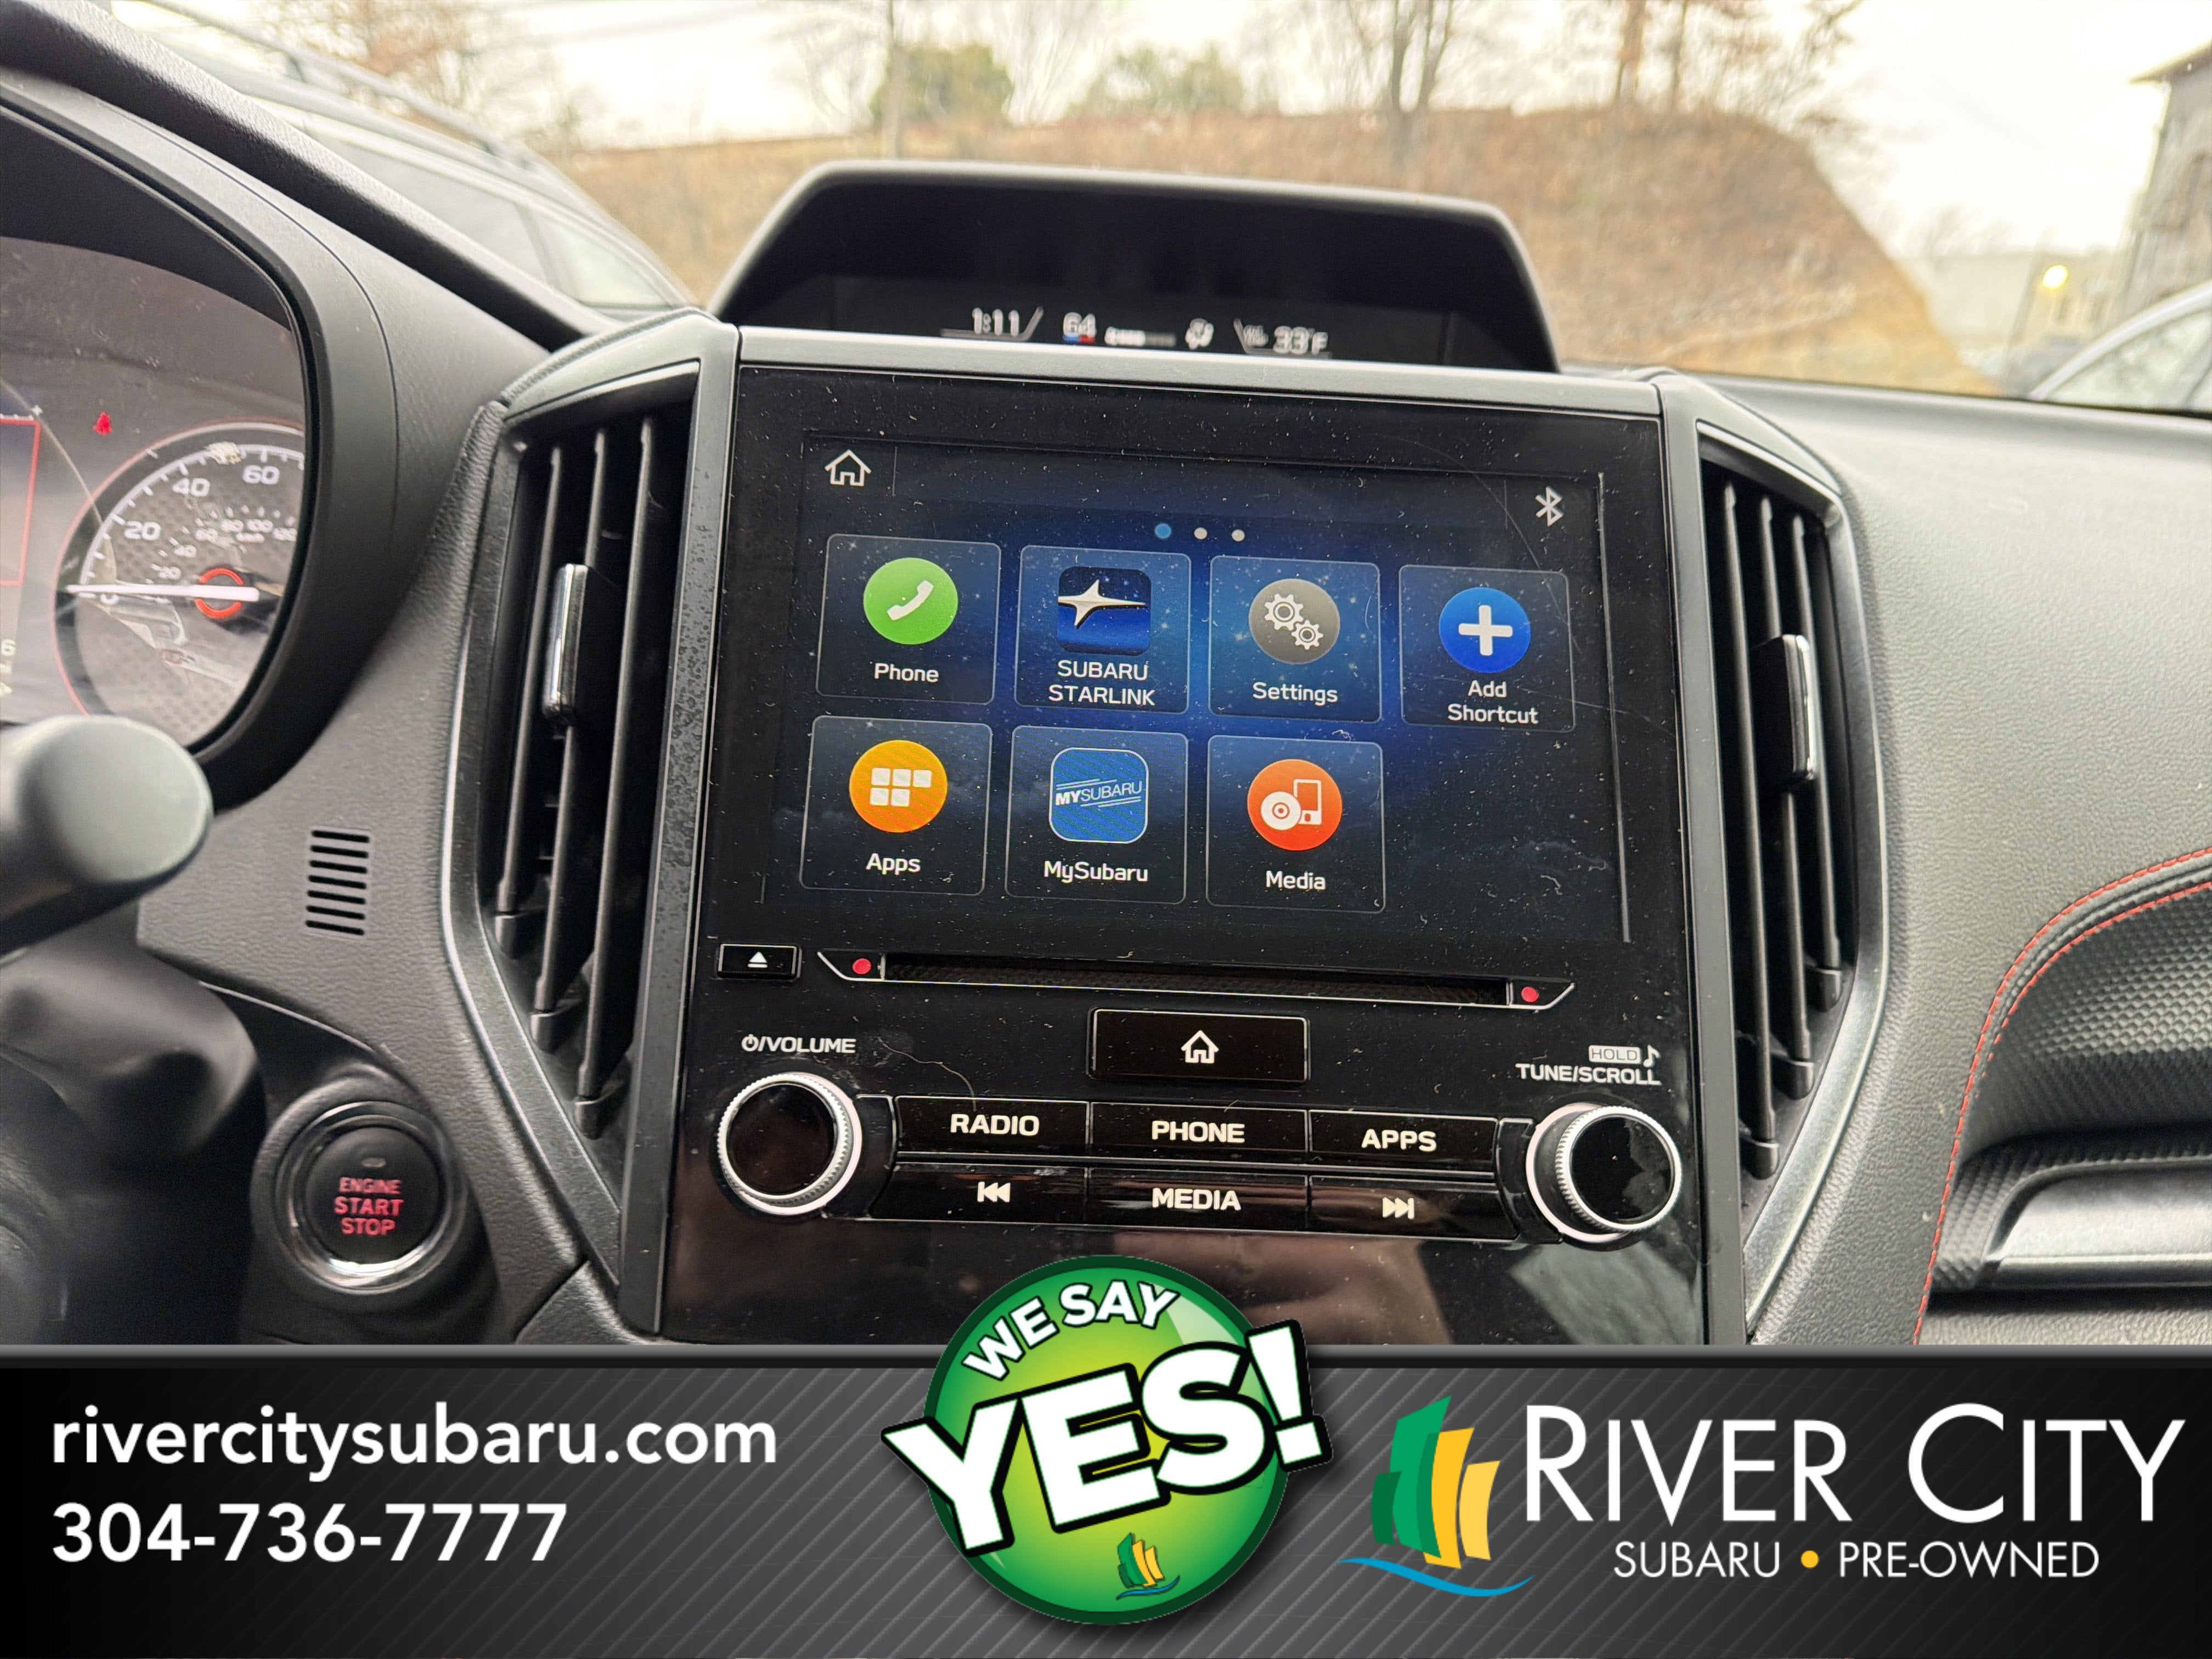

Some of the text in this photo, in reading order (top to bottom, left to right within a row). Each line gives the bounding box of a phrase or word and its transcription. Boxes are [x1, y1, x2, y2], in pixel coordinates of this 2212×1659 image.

[972, 307, 1019, 337] 1:11
[1063, 312, 1096, 337] 64
[243, 465, 279, 485] 60
[173, 478, 210, 498] 40
[124, 521, 161, 540] 20
[874, 663, 939, 682] Phone
[1057, 659, 1148, 681] SUBARU
[1048, 684, 1155, 706] STARLINK
[1252, 682, 1338, 706] Settings
[1468, 680, 1507, 698] Add
[1447, 703, 1539, 725] Shortcut
[1055, 781, 1143, 806] MYSUBARU
[866, 853, 921, 873] Apps
[1044, 861, 1148, 884] MySubaru
[1266, 871, 1326, 890] Media
[1590, 1048, 1639, 1062] HOLD
[1515, 1063, 1662, 1086] TUNE/SCROLL
[950, 1114, 1040, 1136] RADIO
[1152, 1121, 1245, 1143] PHONE
[1361, 1128, 1437, 1152] APPS
[339, 1177, 402, 1195] ENGINE
[334, 1196, 404, 1216] START
[1152, 1188, 1242, 1211] MEDIA
[341, 1217, 396, 1236] STOP
